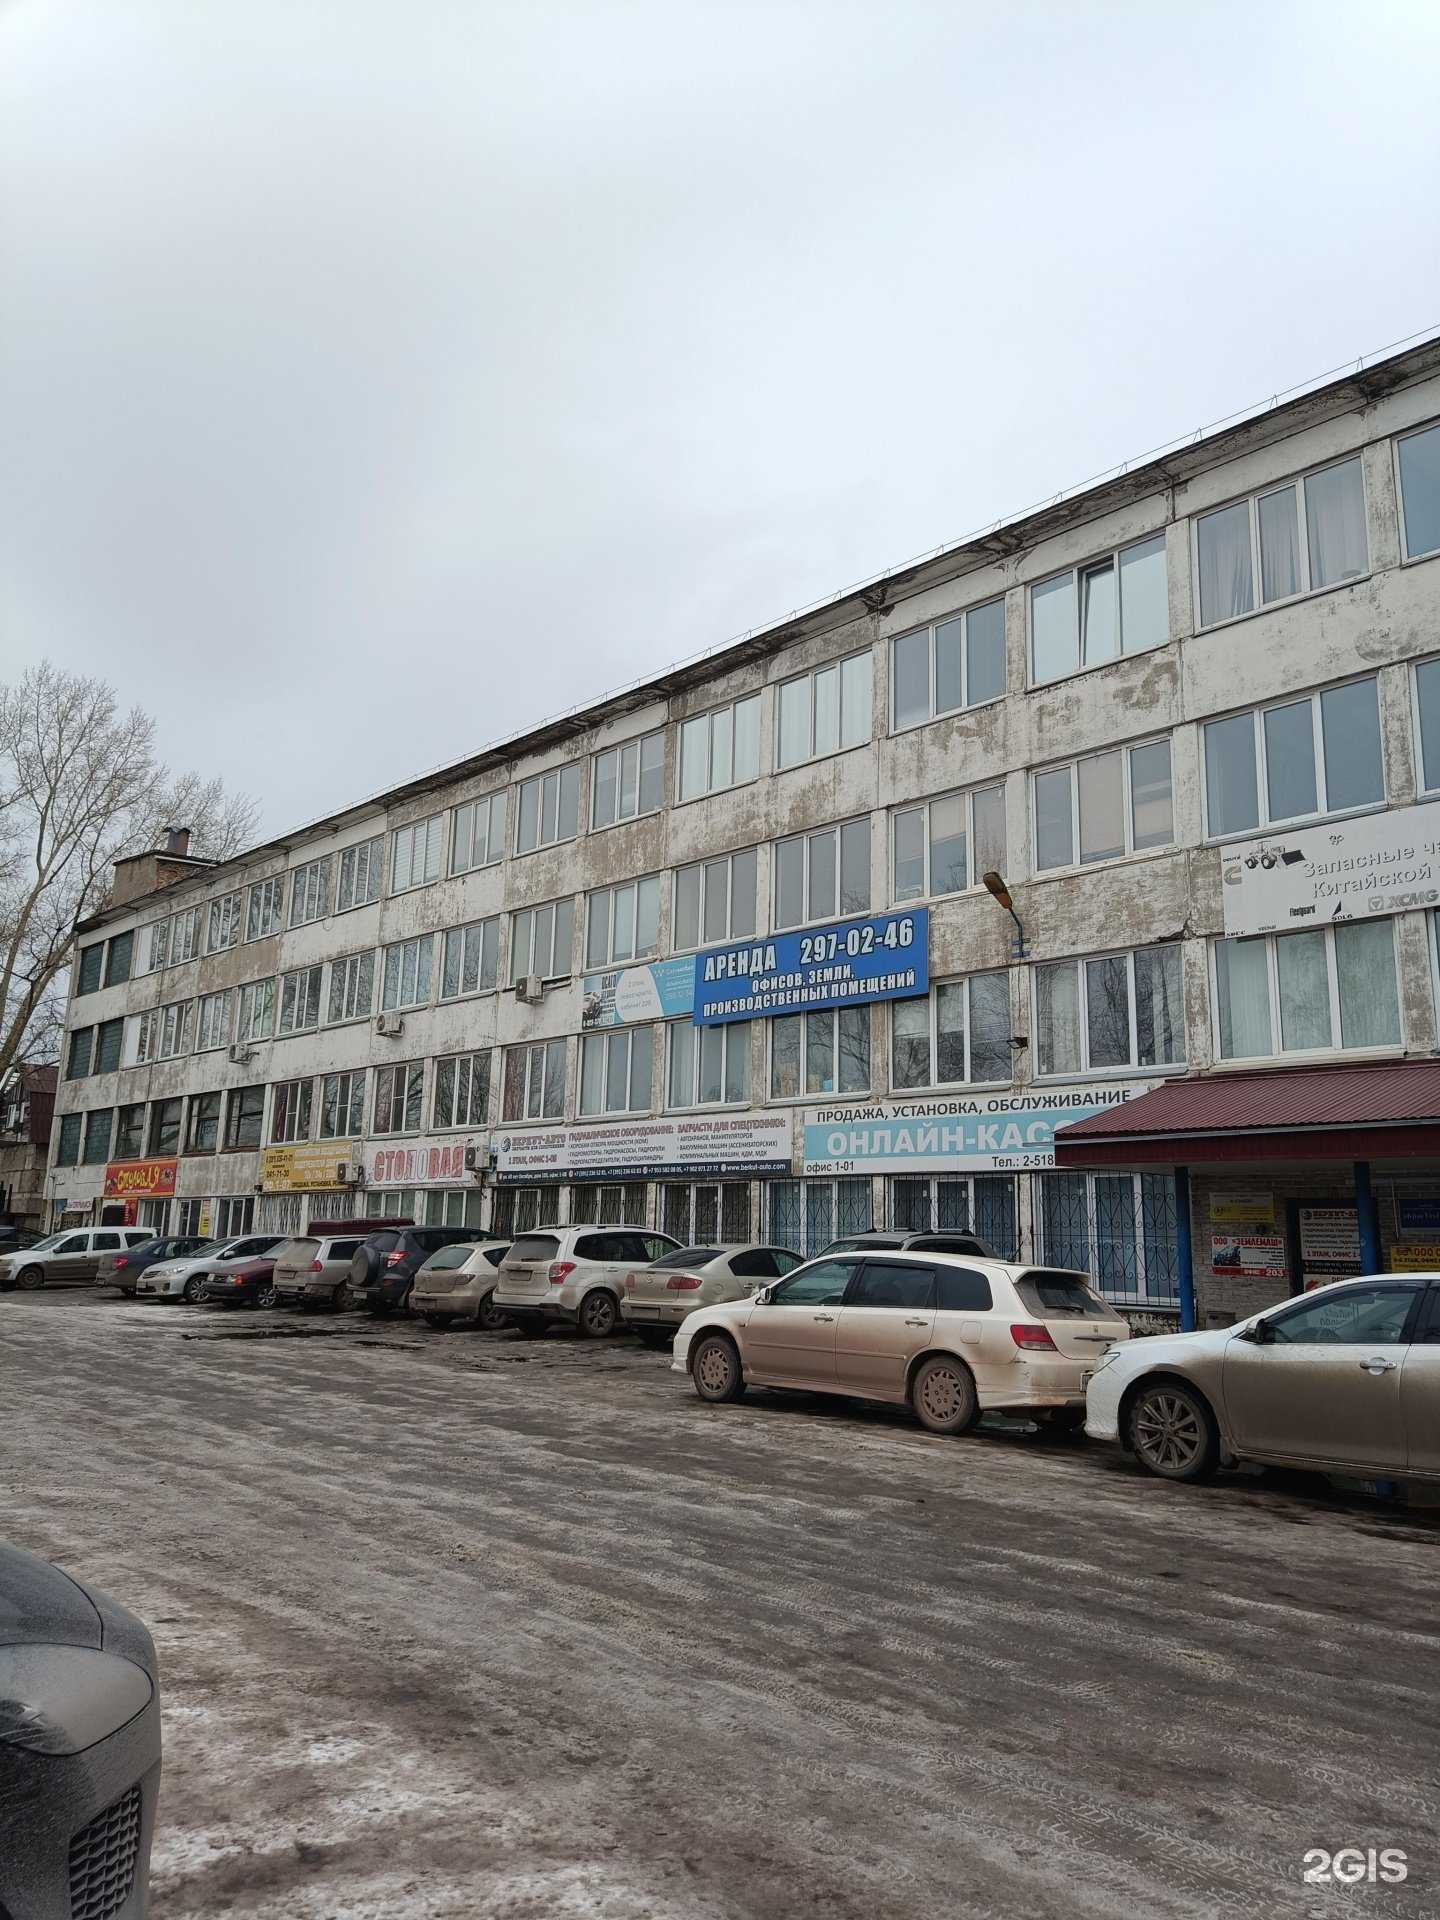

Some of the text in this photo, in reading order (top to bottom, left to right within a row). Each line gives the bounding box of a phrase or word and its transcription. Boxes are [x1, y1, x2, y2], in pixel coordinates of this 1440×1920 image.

[1303, 842, 1440, 877] Запасные ч
[1314, 863, 1431, 898] Китайской
[1388, 889, 1439, 908] XCMG
[704, 918, 914, 981] АРЕНДА 297-02-46
[752, 964, 854, 993] ОФИСОВ, ЗЕМЛИ,
[703, 969, 915, 1017] ПРОИЗВОДСТВЕННЫХ ПОМЕЩЕНИЙ
[817, 1090, 1130, 1123] ПРОДАЖА, УСТАНОВКА, ОБСЛУЖИВАНИЕ
[569, 1125, 673, 1141] ГИДРАВЛИЧЕСКОЕ ОБОРУДОВАНИЕ:
[677, 1118, 785, 1133] ЗАПЧАСТИ ДЛЯ СПЕЦТЕХНИКИ:
[512, 1134, 566, 1146] БЕРКУТ-АВТО
[607, 1139, 633, 1147] МОЩНОСТИ
[711, 1132, 752, 1140] МАНИПУЛЯТОРОВ
[729, 1140, 777, 1149] (АССЕНИЗАТОРСКИХ)
[374, 1145, 464, 1181] СТОЛОВАЯ
[529, 1155, 544, 1163] ОФИС
[992, 1157, 1019, 1167] Тел.:
[727, 1163, 785, 1172] www.berkut-auto.com
[806, 1161, 854, 1174] офис 1-01
[1214, 1237, 1228, 1245] ООО
